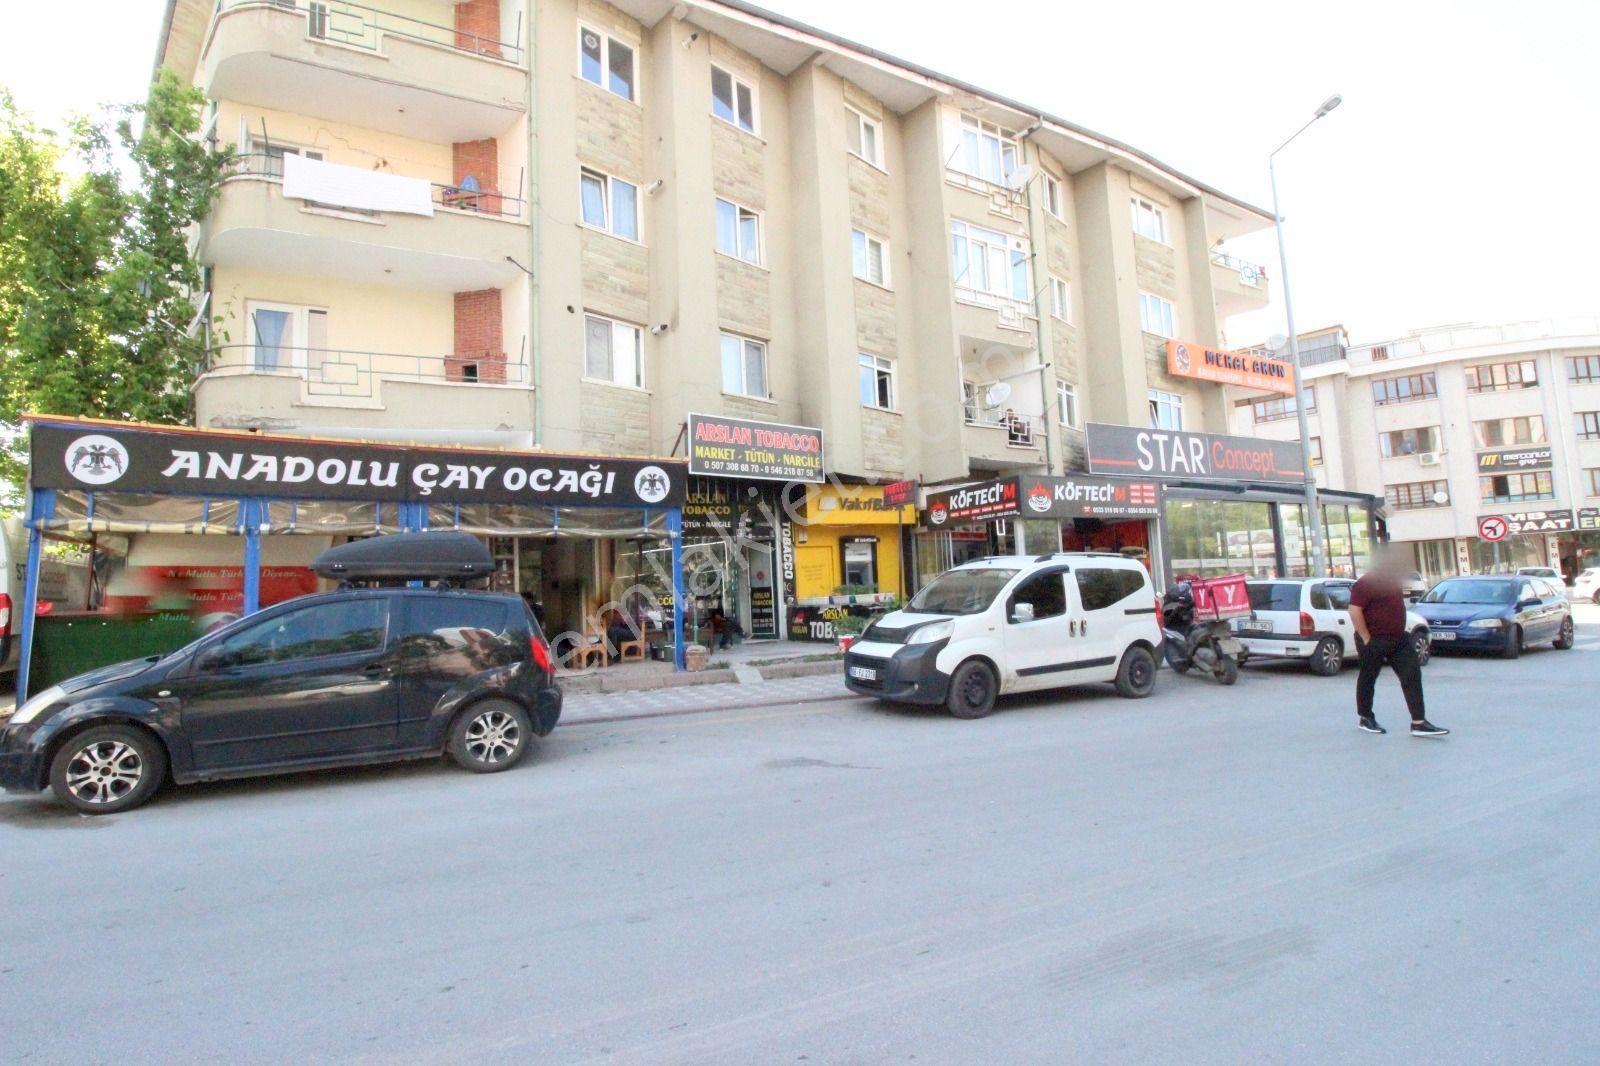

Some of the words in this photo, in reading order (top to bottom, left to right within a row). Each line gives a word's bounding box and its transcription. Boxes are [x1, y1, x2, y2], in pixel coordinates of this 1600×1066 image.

[696, 422, 752, 446] ARSLAN
[754, 428, 820, 453] TOBACCO
[695, 446, 736, 460] MARKET
[744, 448, 775, 464] TÜTÜN
[783, 454, 820, 468] NARGİLE
[712, 461, 724, 470] 507
[1136, 432, 1206, 474] STAR
[1212, 441, 1277, 477] Concept
[161, 449, 400, 487] ANADOLU
[412, 463, 497, 496] ÇAY
[503, 464, 616, 497] OCAĞI
[1508, 519, 1571, 531] SAAT
[781, 522, 794, 580] TOBACCO
[1224, 584, 1236, 604] Y
